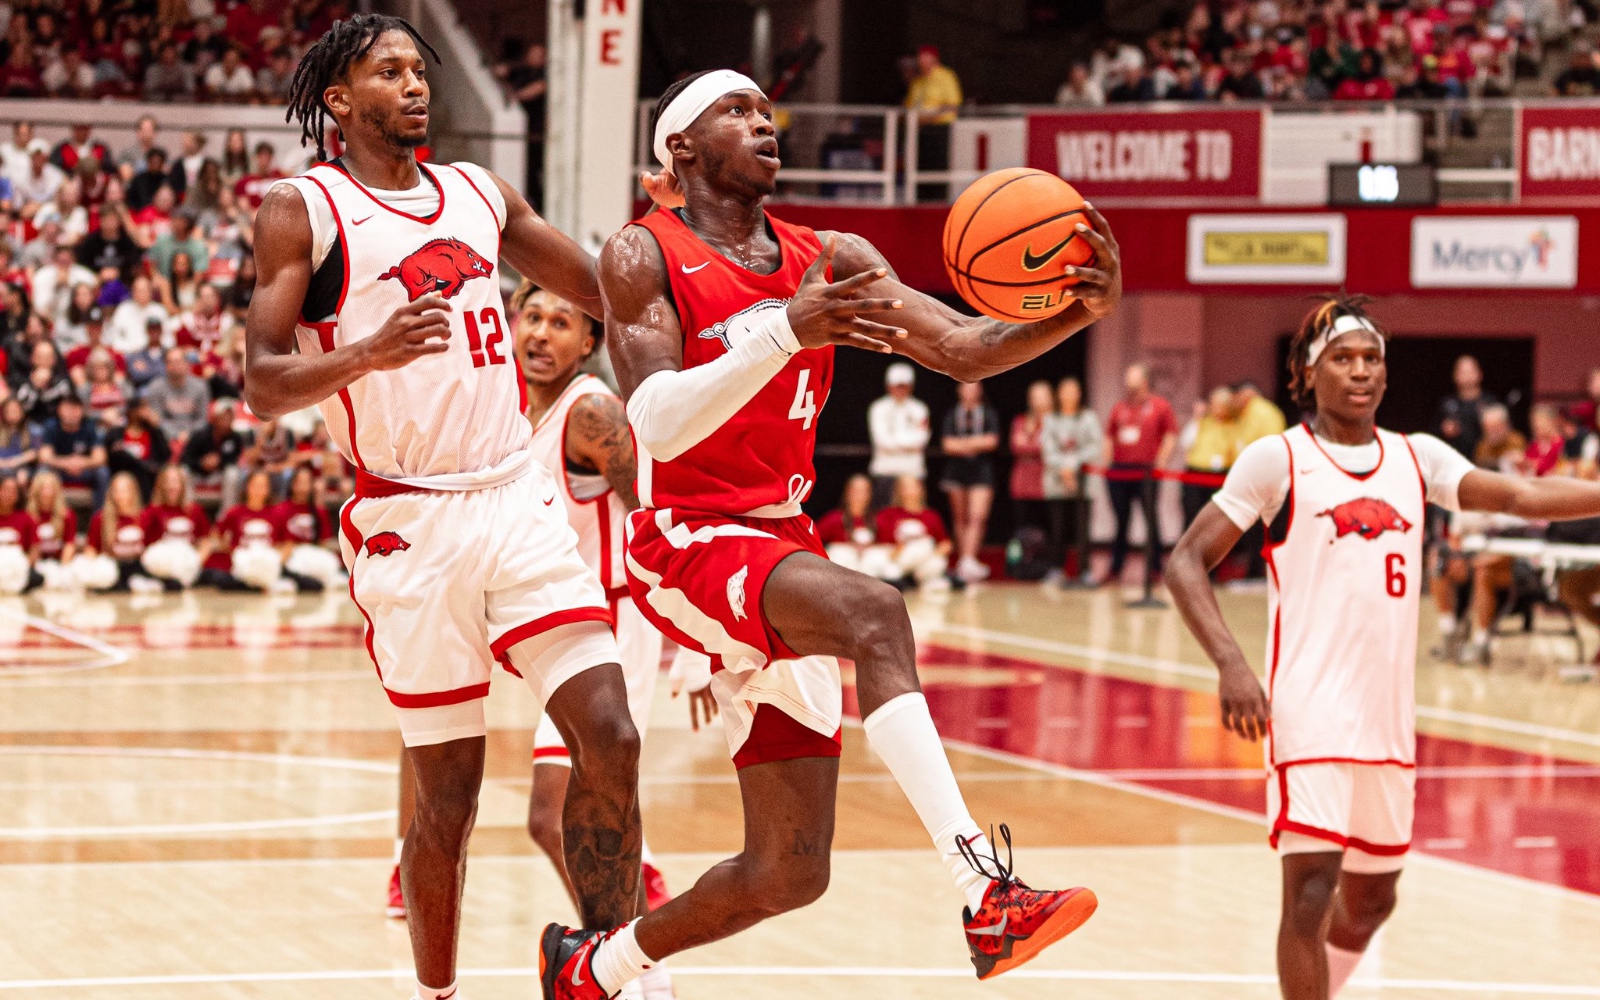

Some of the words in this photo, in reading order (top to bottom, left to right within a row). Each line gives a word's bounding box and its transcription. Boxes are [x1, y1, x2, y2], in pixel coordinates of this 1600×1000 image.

[1056, 131, 1191, 181] WELCOME
[1196, 130, 1233, 181] TO
[1432, 238, 1528, 279] Mercy
[463, 307, 506, 368] 12
[788, 368, 816, 430] 4
[1385, 553, 1406, 598] 6
